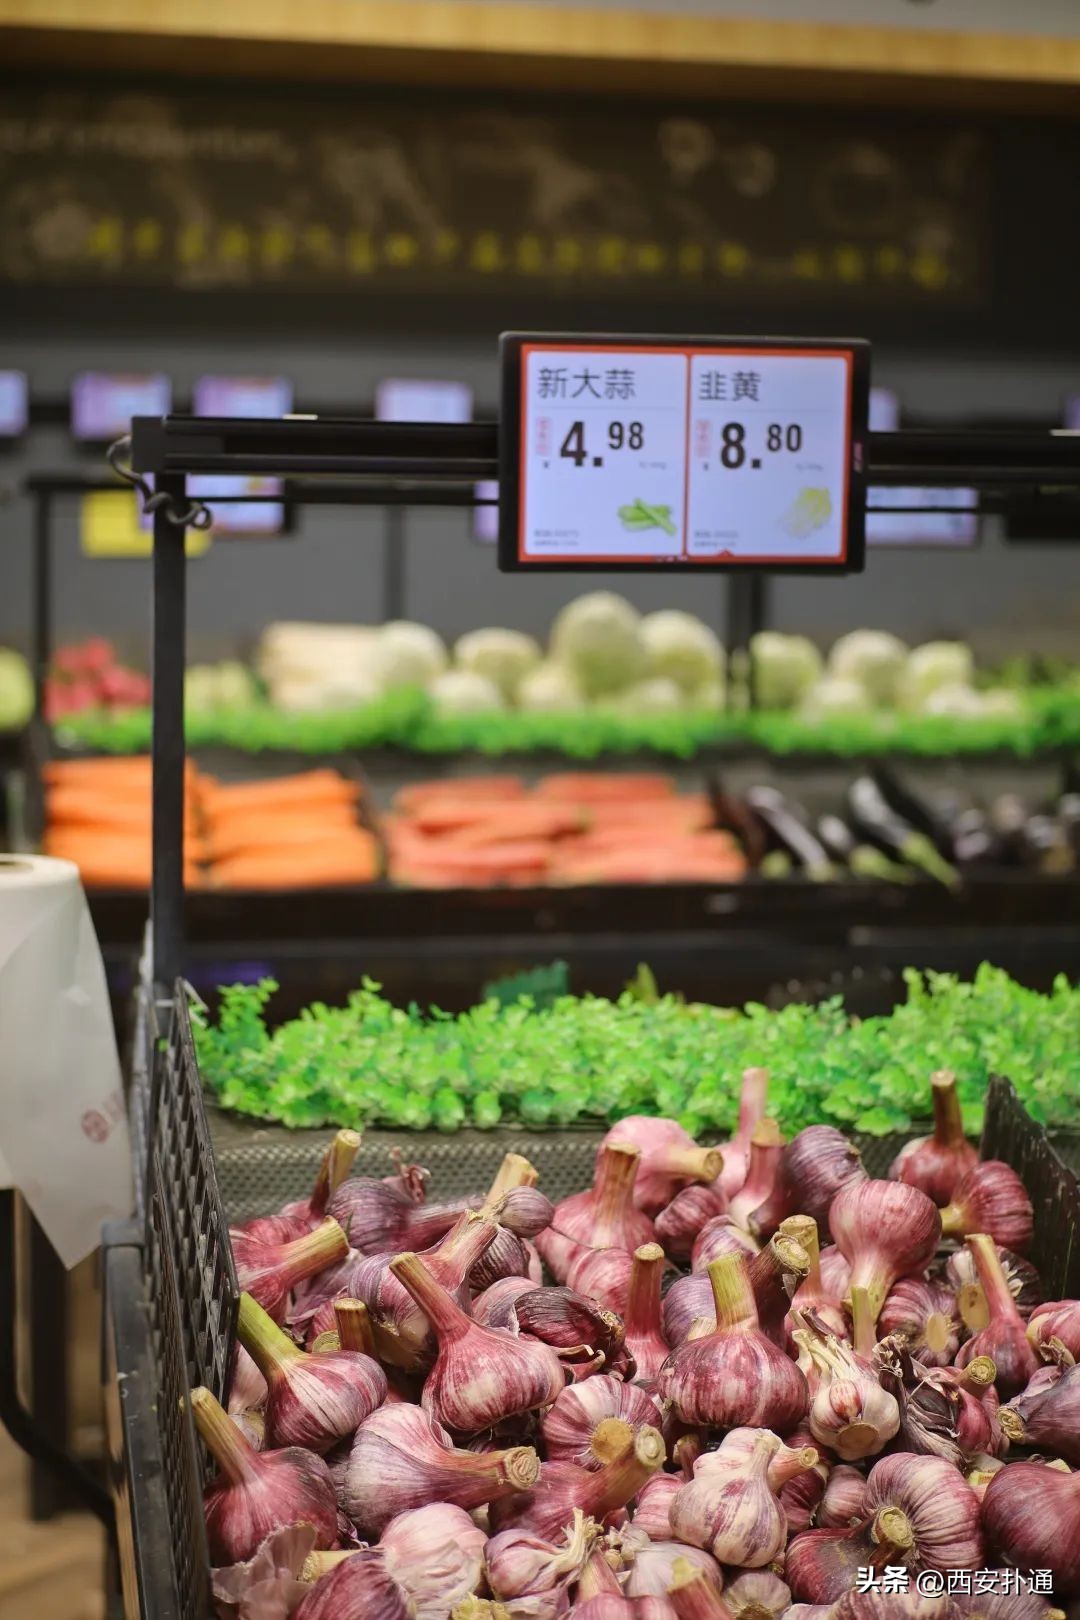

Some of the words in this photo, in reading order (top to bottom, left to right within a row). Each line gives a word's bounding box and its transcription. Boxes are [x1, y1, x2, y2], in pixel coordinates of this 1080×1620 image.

[538, 368, 636, 400] 新大蒜
[698, 370, 761, 402] 韭黄
[560, 421, 644, 467] 4.98
[720, 422, 802, 469] 8.80
